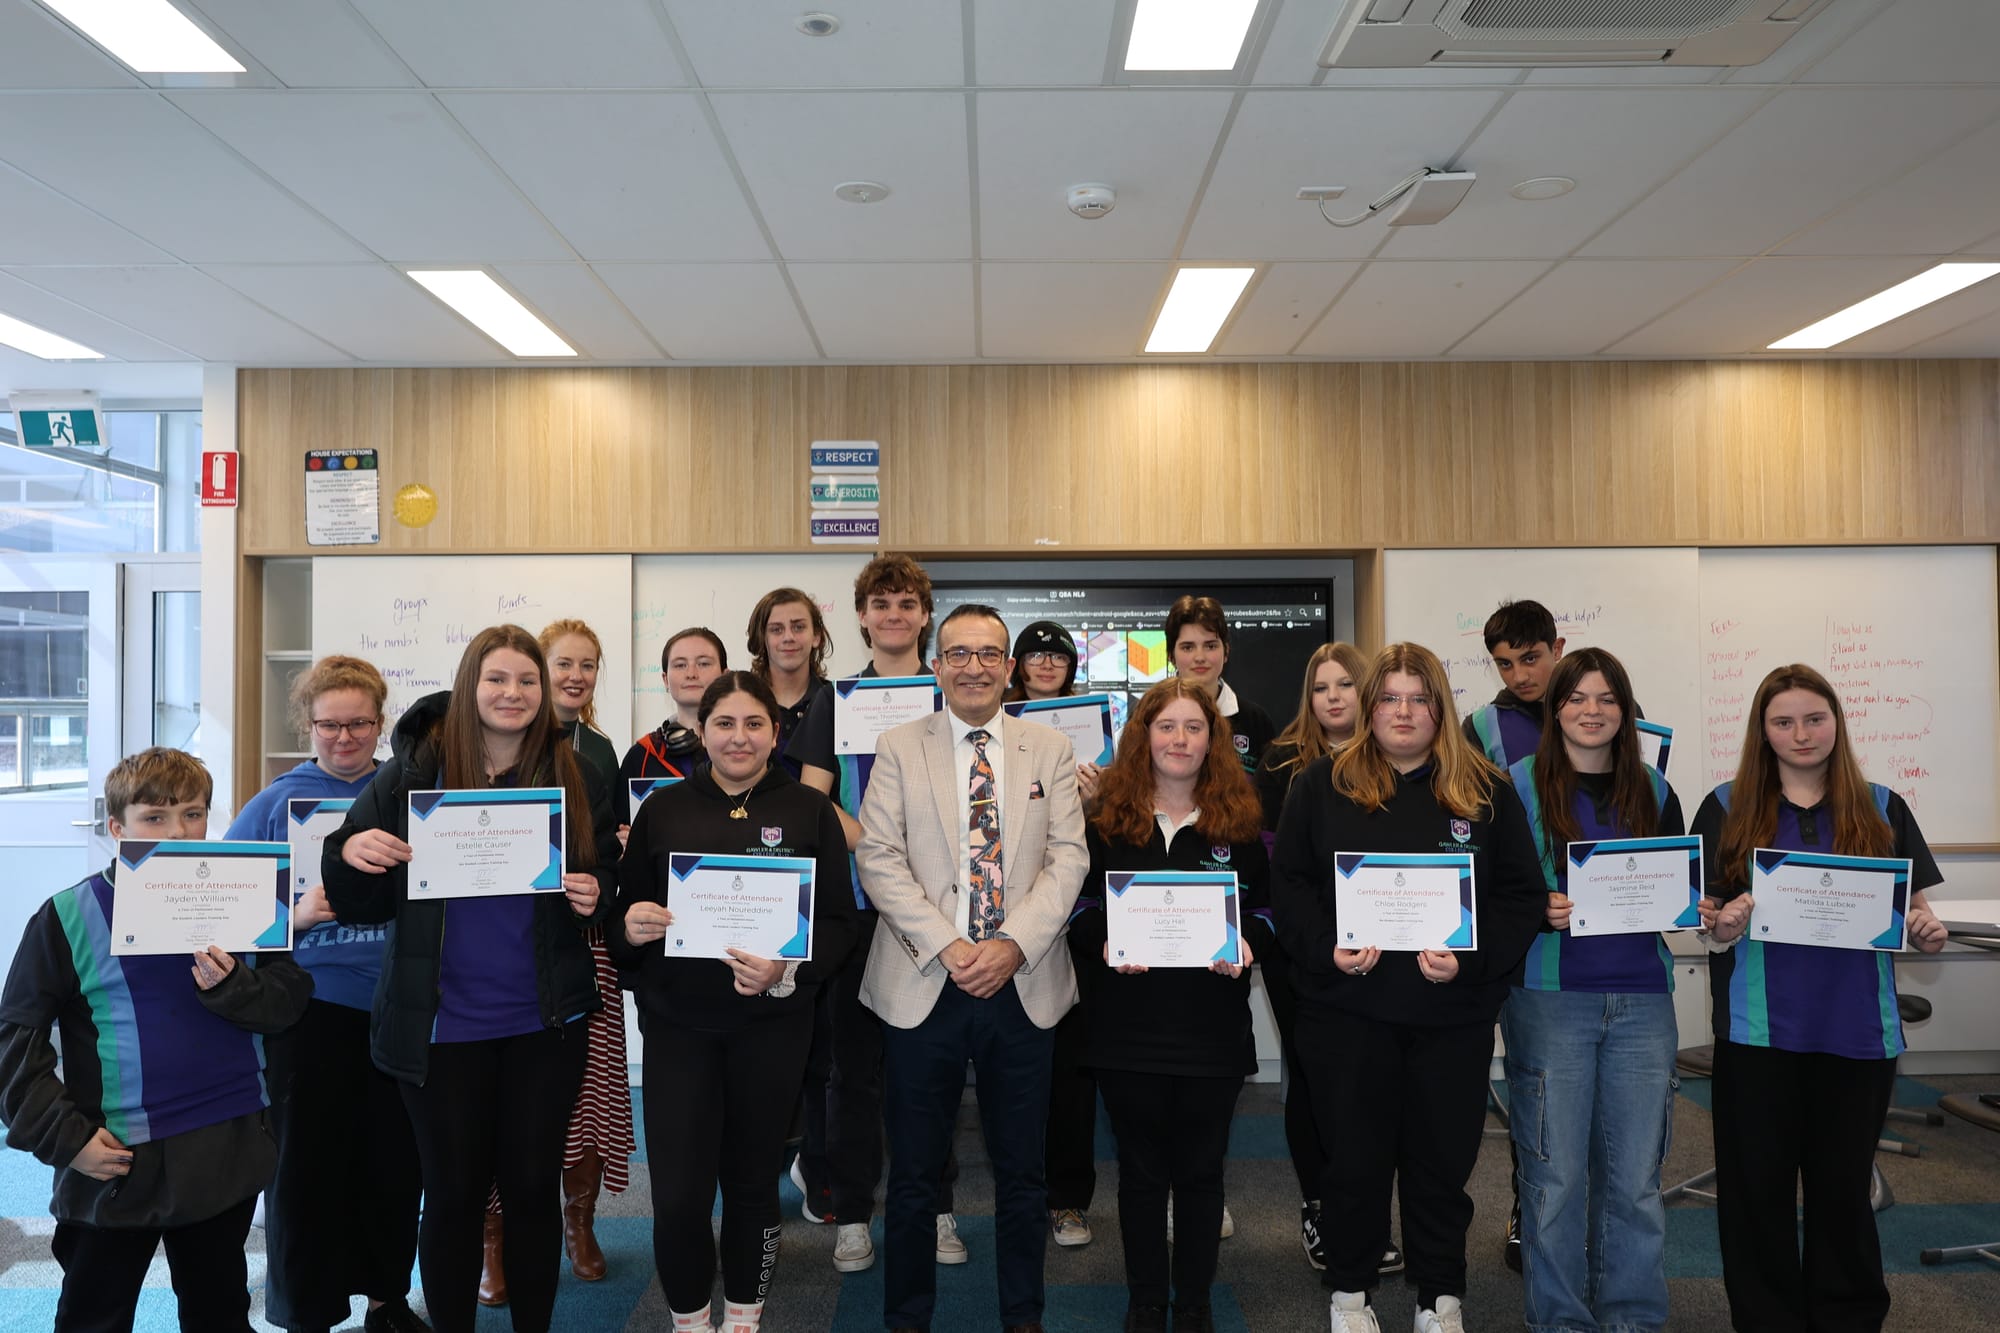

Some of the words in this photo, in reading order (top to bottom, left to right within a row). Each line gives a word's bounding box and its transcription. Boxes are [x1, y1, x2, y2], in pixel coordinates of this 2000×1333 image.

[331, 448, 373, 456] EXPECTATIONS
[825, 452, 873, 462] RESPECT
[824, 488, 877, 498] GENEROSITY
[824, 523, 877, 533] EXCELLENCE
[434, 830, 476, 839] Certificate
[477, 829, 487, 837] of
[488, 828, 533, 836] Attendance
[456, 842, 483, 850] Estelle
[484, 841, 512, 849] Causer
[145, 882, 195, 891] Certificate
[196, 882, 206, 890] of
[206, 882, 258, 890] Attendance
[1608, 884, 1637, 892] Jasmine
[1357, 889, 1393, 897] Certificate
[1402, 889, 1445, 897] Attendance
[1776, 885, 1817, 895] Certificate
[1818, 888, 1828, 896] of
[1829, 889, 1876, 899] Attendance
[164, 895, 198, 904] Jayden
[200, 895, 239, 903] Williams
[690, 892, 730, 901] Certificate
[739, 895, 783, 903] Attendance
[1375, 900, 1396, 908] Chloe
[1397, 901, 1427, 909] Rodgers
[1795, 898, 1825, 906] Matilda
[1826, 900, 1856, 908] Lubcke
[700, 905, 727, 913] Leeyah
[728, 906, 774, 914] Noureddine
[1154, 918, 1171, 926] Lucy
